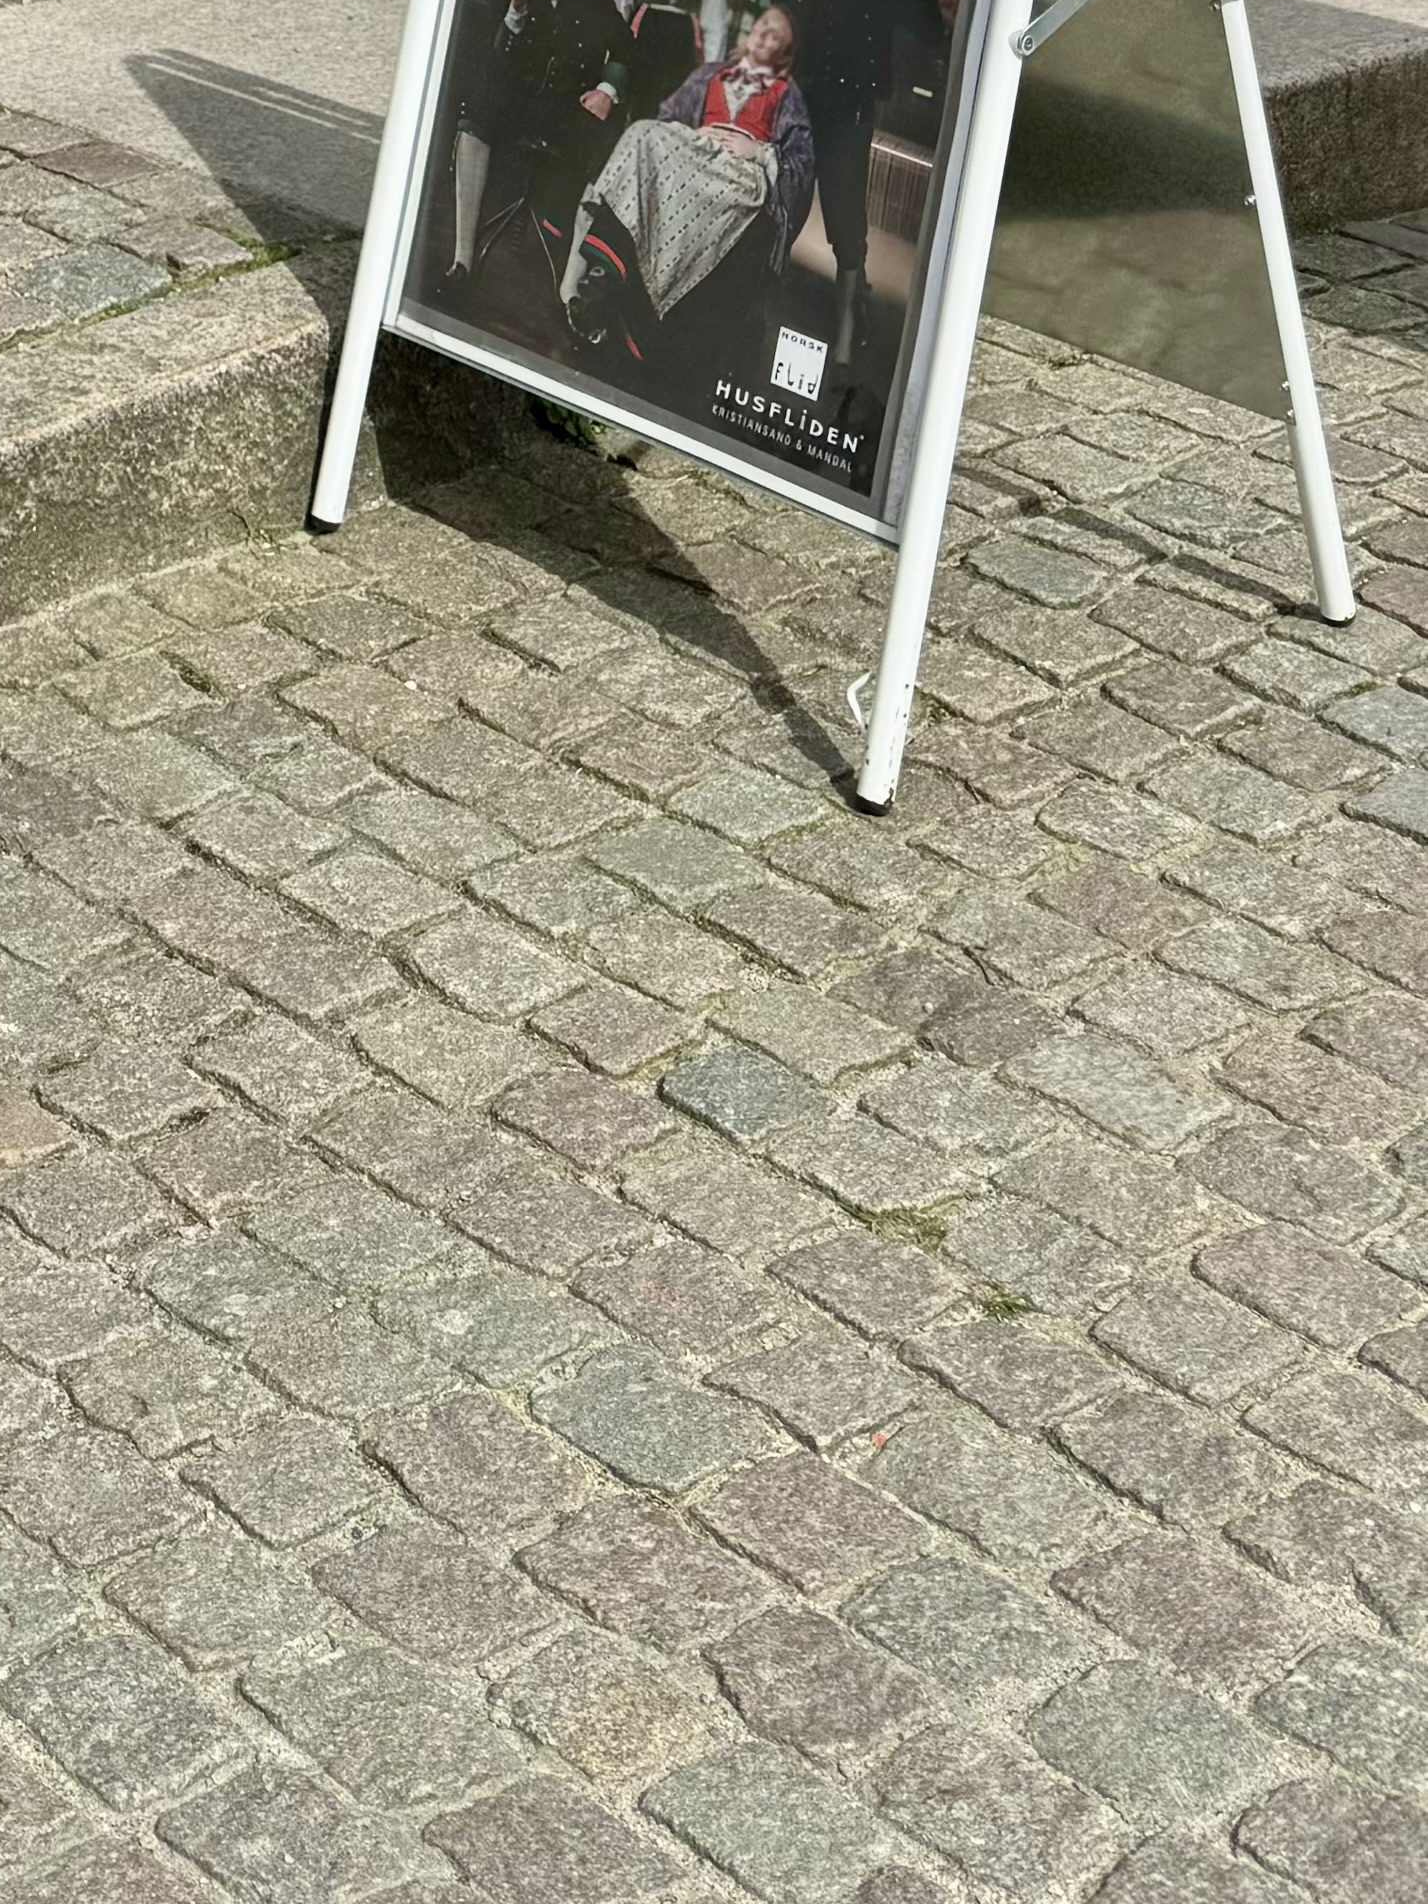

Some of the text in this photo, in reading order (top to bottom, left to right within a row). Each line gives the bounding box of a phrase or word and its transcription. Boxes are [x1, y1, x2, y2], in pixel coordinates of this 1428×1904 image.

[712, 403, 852, 473] KRISTIANSAND & MANDAL
